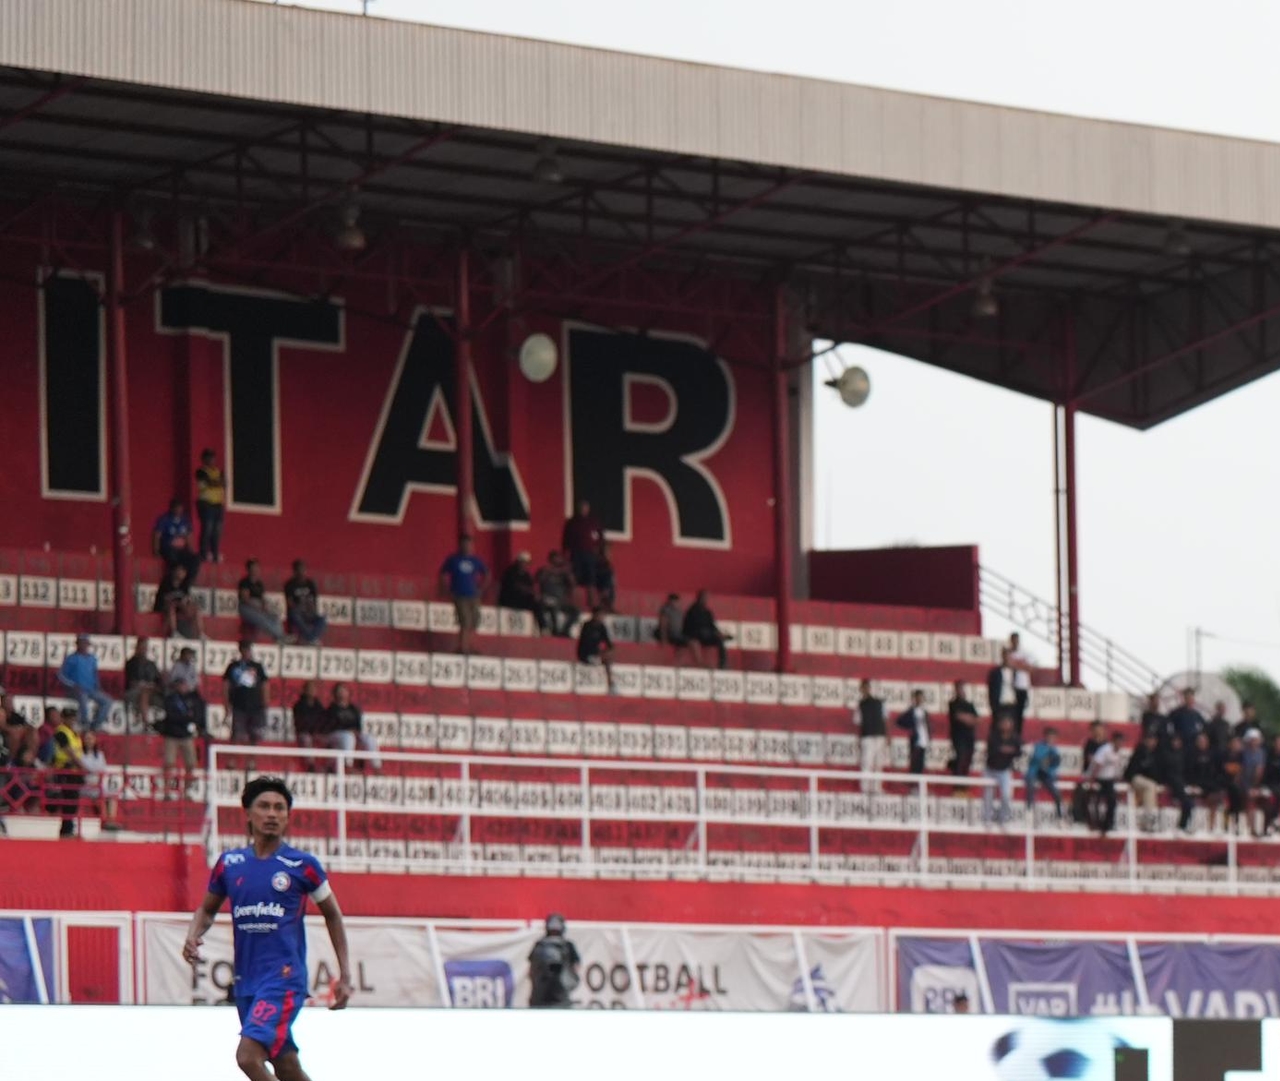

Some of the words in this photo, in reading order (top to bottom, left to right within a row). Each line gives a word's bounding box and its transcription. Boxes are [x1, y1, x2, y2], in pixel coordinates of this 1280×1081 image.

[22, 582, 50, 600] 112
[10, 636, 41, 658] 278
[284, 650, 314, 672] 271
[322, 653, 353, 672] 270
[233, 901, 285, 919] Greenfields
[584, 963, 728, 994] OOTBALL
[451, 975, 506, 1009] BRI
[252, 999, 277, 1021] 87
